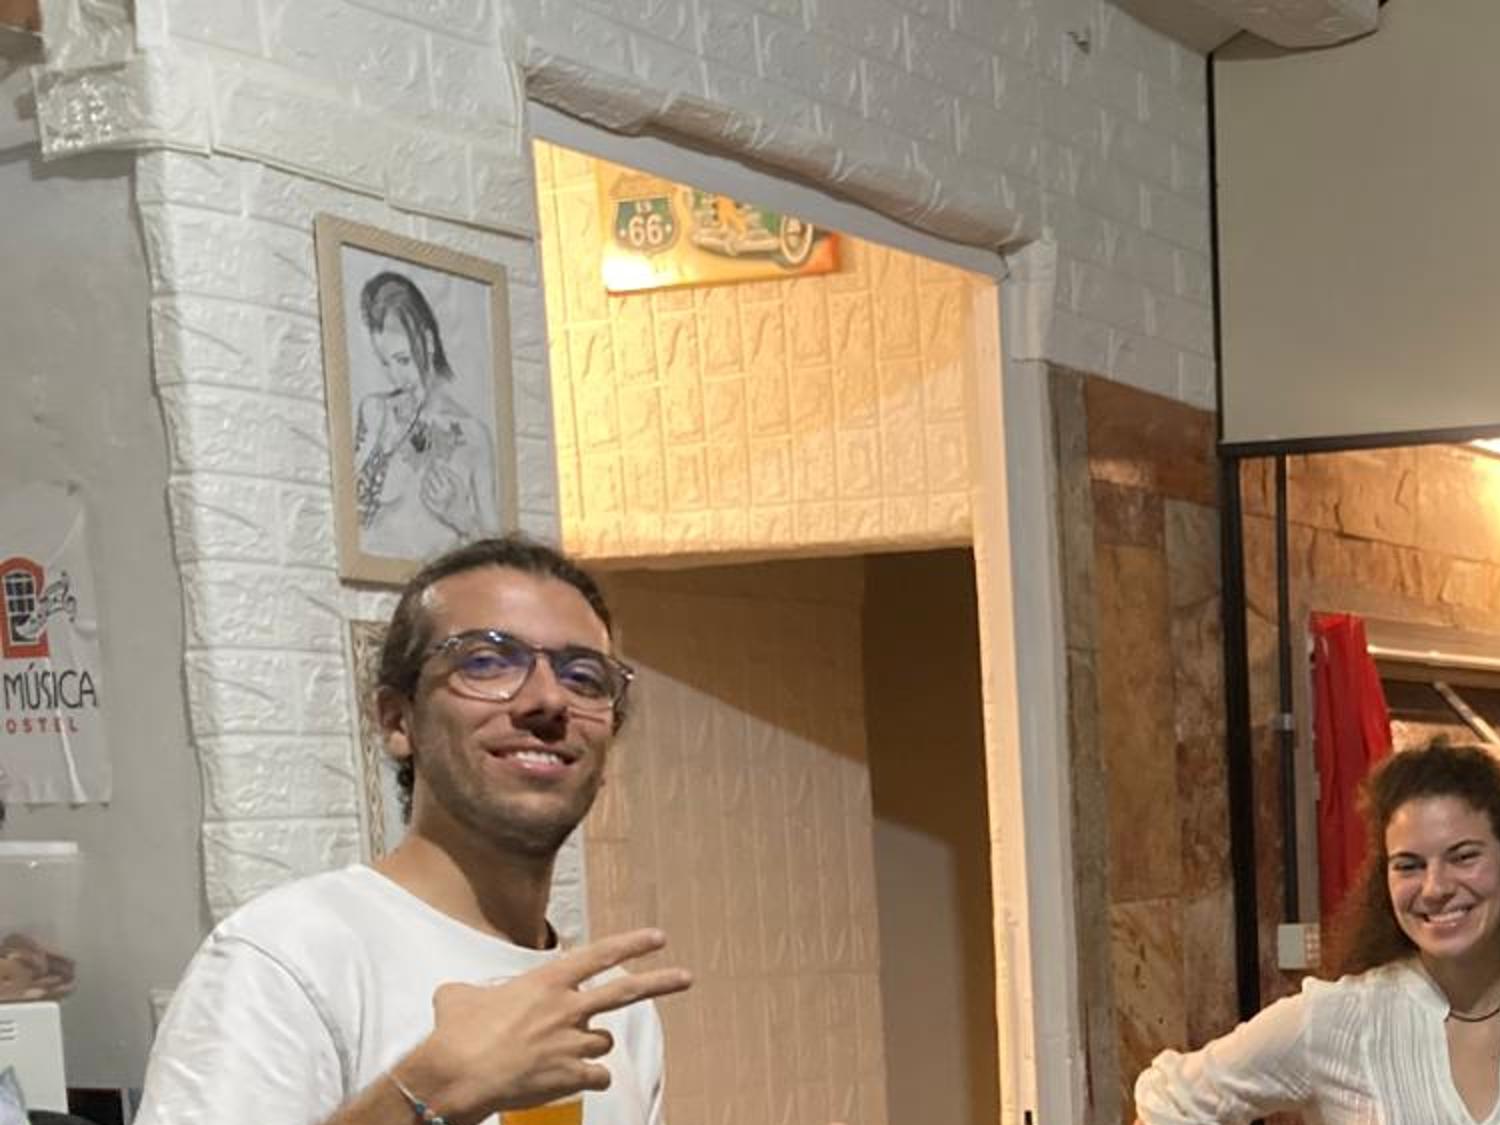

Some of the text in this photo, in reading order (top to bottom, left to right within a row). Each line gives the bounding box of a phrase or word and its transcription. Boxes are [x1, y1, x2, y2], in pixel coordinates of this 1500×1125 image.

[628, 213, 664, 247] 66
[3, 662, 98, 712] MÚSICA
[0, 717, 79, 735] OSTEL
